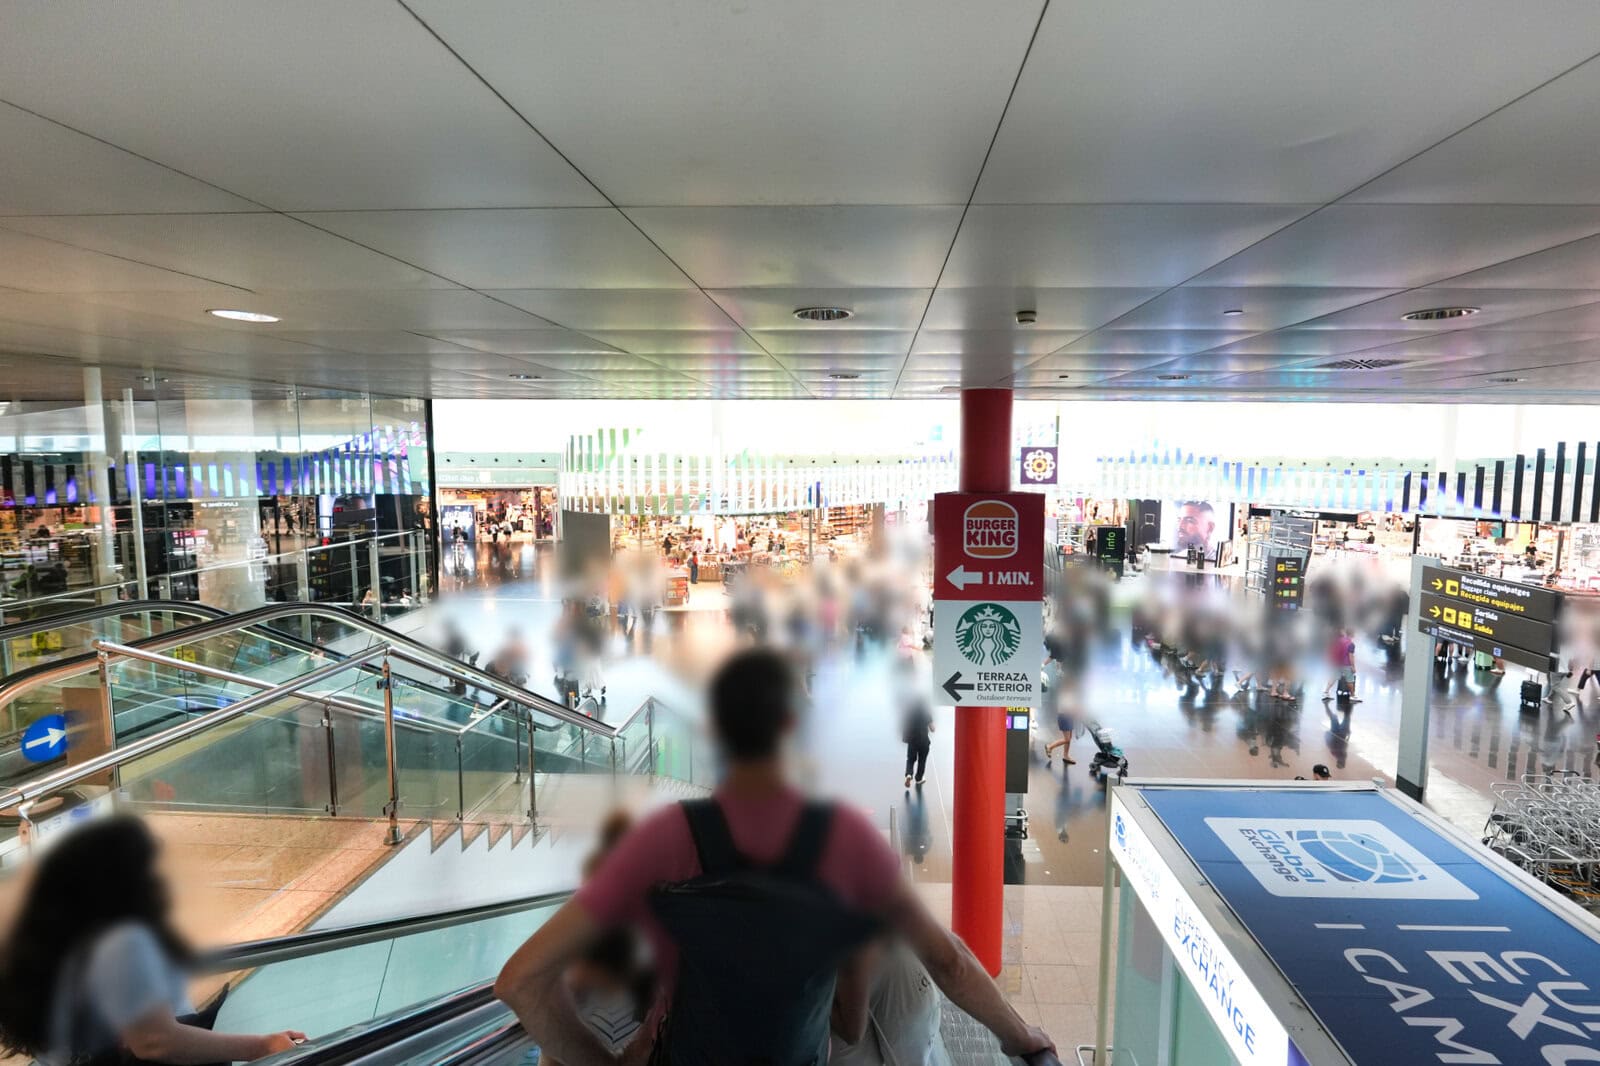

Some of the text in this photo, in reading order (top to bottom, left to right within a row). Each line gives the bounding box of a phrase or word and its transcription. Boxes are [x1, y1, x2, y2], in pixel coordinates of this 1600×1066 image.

[966, 519, 1016, 530] BURGER
[966, 531, 1016, 546] KING
[1106, 532, 1116, 550] info
[988, 572, 1034, 585] 1 MIN.
[1461, 576, 1530, 598] Recollida equipatges
[1460, 591, 1525, 612] Recogida equipajes
[1474, 609, 1498, 621] Sortida
[1473, 624, 1493, 635] Salida
[977, 672, 1029, 682] TERRAZA
[977, 683, 1032, 693] EXTERIOR
[976, 693, 1032, 702] Outdoor terrace
[1238, 828, 1300, 883] Exchange
[1256, 828, 1326, 883] Global
[1173, 915, 1256, 1055] EXCHANGE
